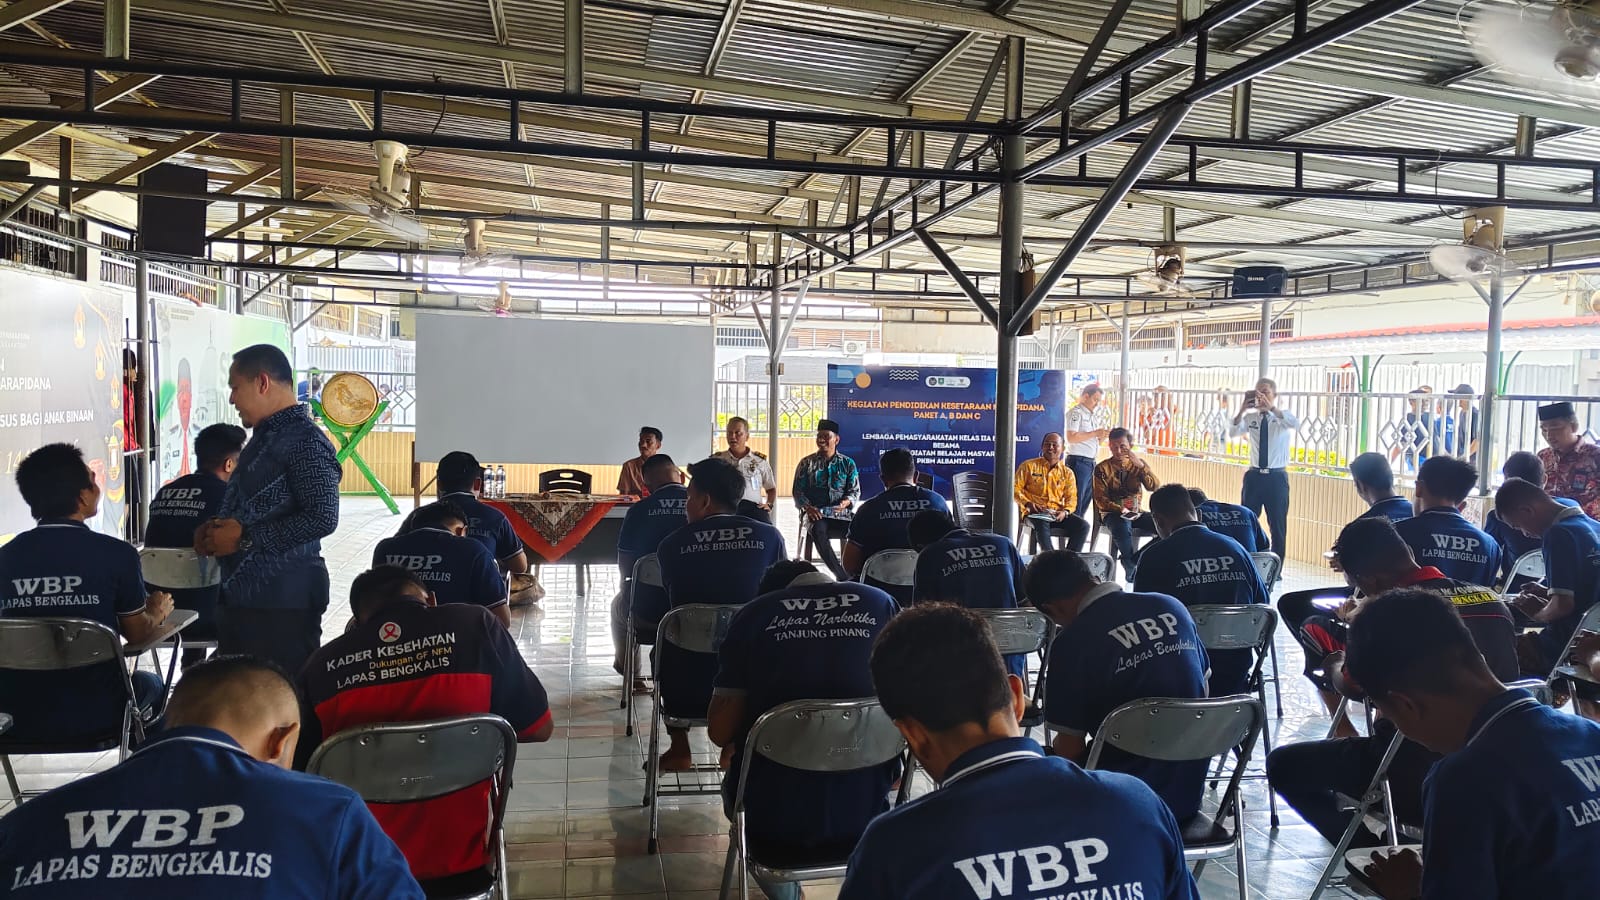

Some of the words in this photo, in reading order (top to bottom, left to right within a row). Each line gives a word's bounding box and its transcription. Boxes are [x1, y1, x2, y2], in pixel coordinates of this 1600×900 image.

[847, 401, 889, 409] KEGIATAN
[890, 402, 940, 410] PENDIDIKAN
[941, 402, 992, 411] KESETARAAN
[0, 413, 18, 428] SUS
[20, 412, 42, 426] BAGI
[44, 411, 64, 425] ANAK
[66, 409, 94, 423] BINAAN
[959, 434, 979, 442] KELAS
[161, 488, 202, 499] WBP
[888, 500, 930, 510] WBP
[1203, 510, 1241, 520] WBP
[694, 527, 753, 543] WBP
[1431, 533, 1480, 552] WBP
[680, 543, 711, 554] LAPAS
[712, 540, 765, 550] BENGKALIS
[947, 544, 997, 561] WBP
[1422, 548, 1446, 558] LAPAS
[1447, 550, 1488, 564] BENGKALIS
[385, 555, 442, 570] WBP
[942, 561, 968, 576] LAPAS
[1181, 555, 1234, 574] WBP
[12, 576, 82, 595] WBP
[1, 597, 32, 609] LAPAS
[35, 594, 100, 606] BENGKALIS
[780, 594, 860, 610] WBP
[765, 616, 809, 631] Lapas
[813, 611, 877, 625] Narkotika
[775, 630, 827, 641] TANJUNG
[830, 628, 870, 638] PINANG
[1108, 612, 1178, 649] WBP
[326, 649, 372, 671] KADER
[377, 632, 456, 657] KESEHATAN
[369, 656, 413, 669] Dukungan
[416, 651, 428, 660] GF
[431, 646, 452, 656] NFM
[1115, 649, 1153, 674] Lapas
[337, 671, 376, 689] LAPAS
[380, 656, 450, 679] BENGKALIS
[1566, 798, 1600, 827] LAP
[64, 804, 245, 849] WBP
[11, 854, 100, 890] LAPAS
[107, 851, 272, 879] BENGKALIS
[953, 838, 1109, 900] WBP
